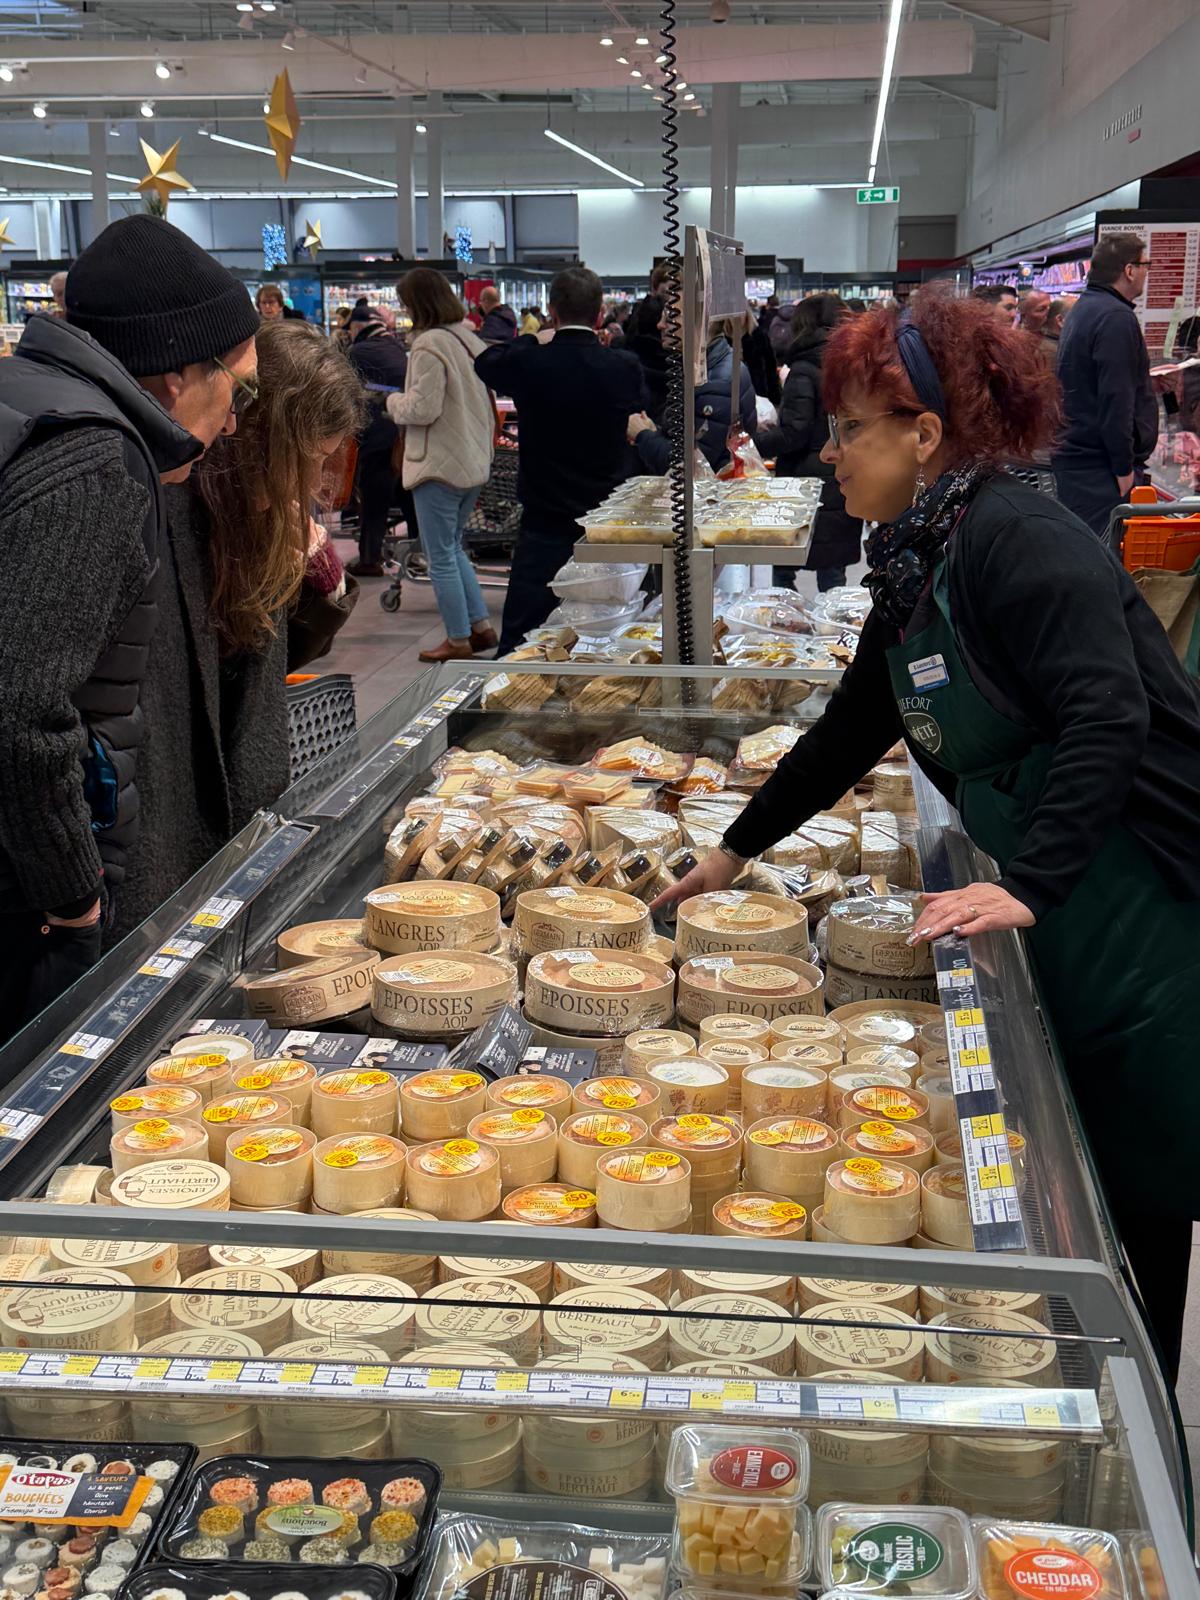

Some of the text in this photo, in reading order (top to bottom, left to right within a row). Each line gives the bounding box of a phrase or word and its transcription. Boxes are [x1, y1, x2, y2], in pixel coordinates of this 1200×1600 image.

[371, 915, 446, 942] LANGRES
[384, 989, 473, 1016] EPOISSES
[540, 987, 630, 1016] EPOISSES
[441, 1016, 468, 1029] AOP
[147, 1177, 217, 1185] BERTHAUT
[50, 1300, 114, 1318] EPOISSES
[742, 1450, 763, 1488] EMMENTAL
[895, 1535, 914, 1571] BASILIC
[1015, 1570, 1093, 1587] CHEDDAR
